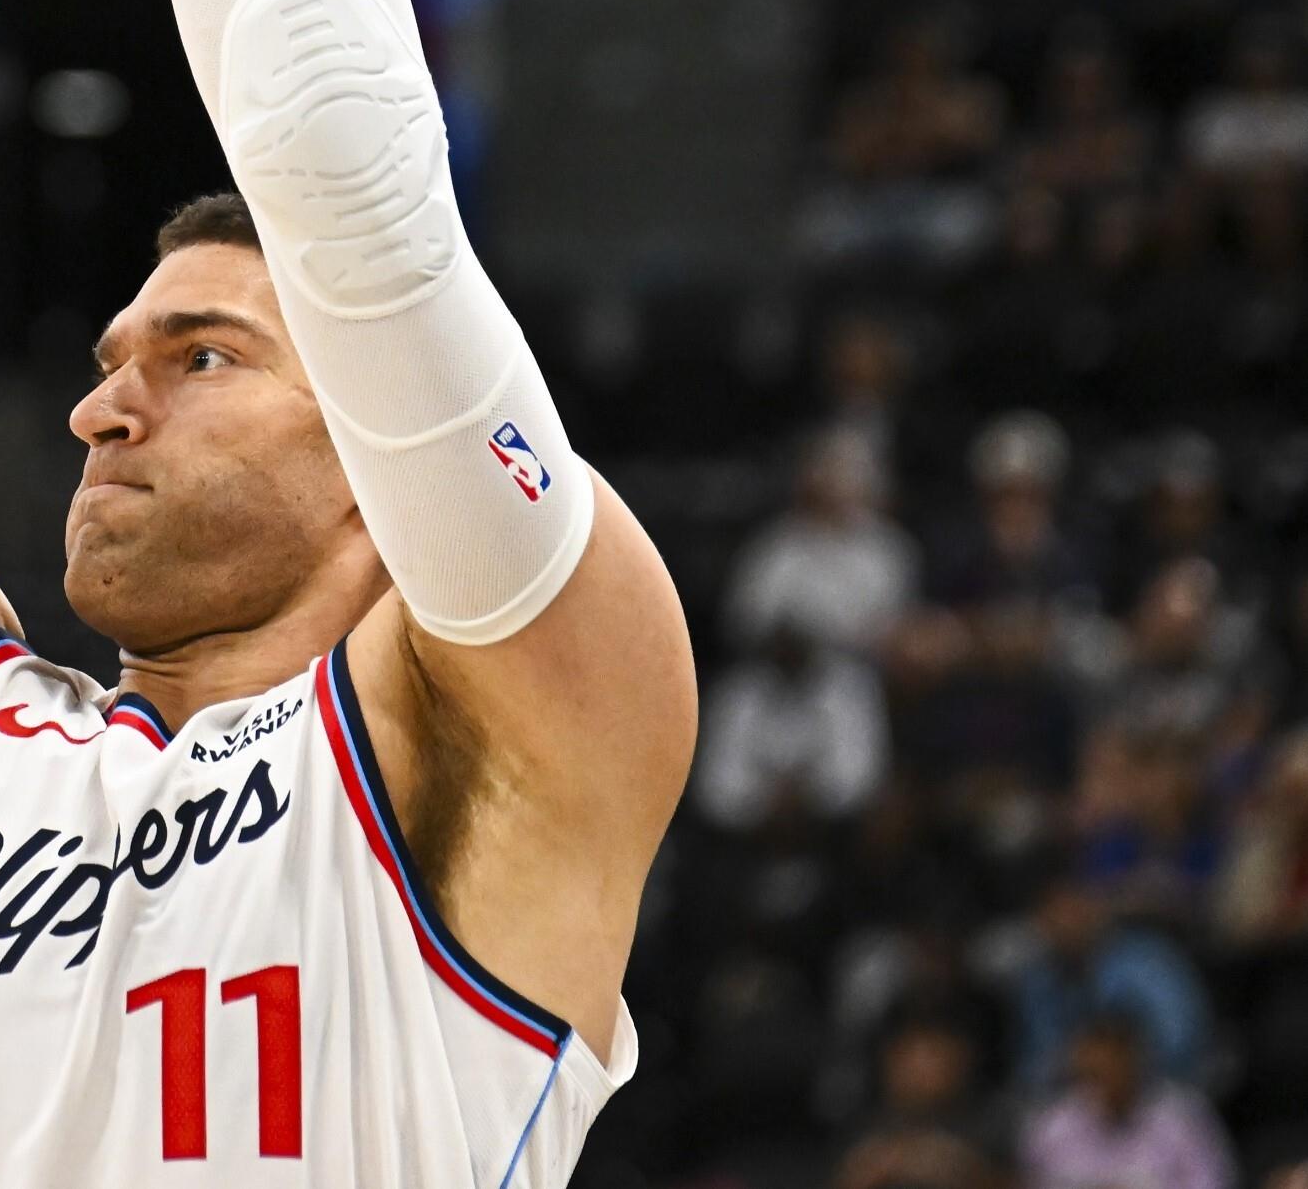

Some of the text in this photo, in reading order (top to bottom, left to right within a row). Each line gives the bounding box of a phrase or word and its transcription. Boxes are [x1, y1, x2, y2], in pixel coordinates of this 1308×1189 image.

[498, 426, 515, 445] NBA
[190, 698, 303, 763] RWANDA
[223, 699, 287, 745] VISIT
[125, 965, 302, 1160] 11
